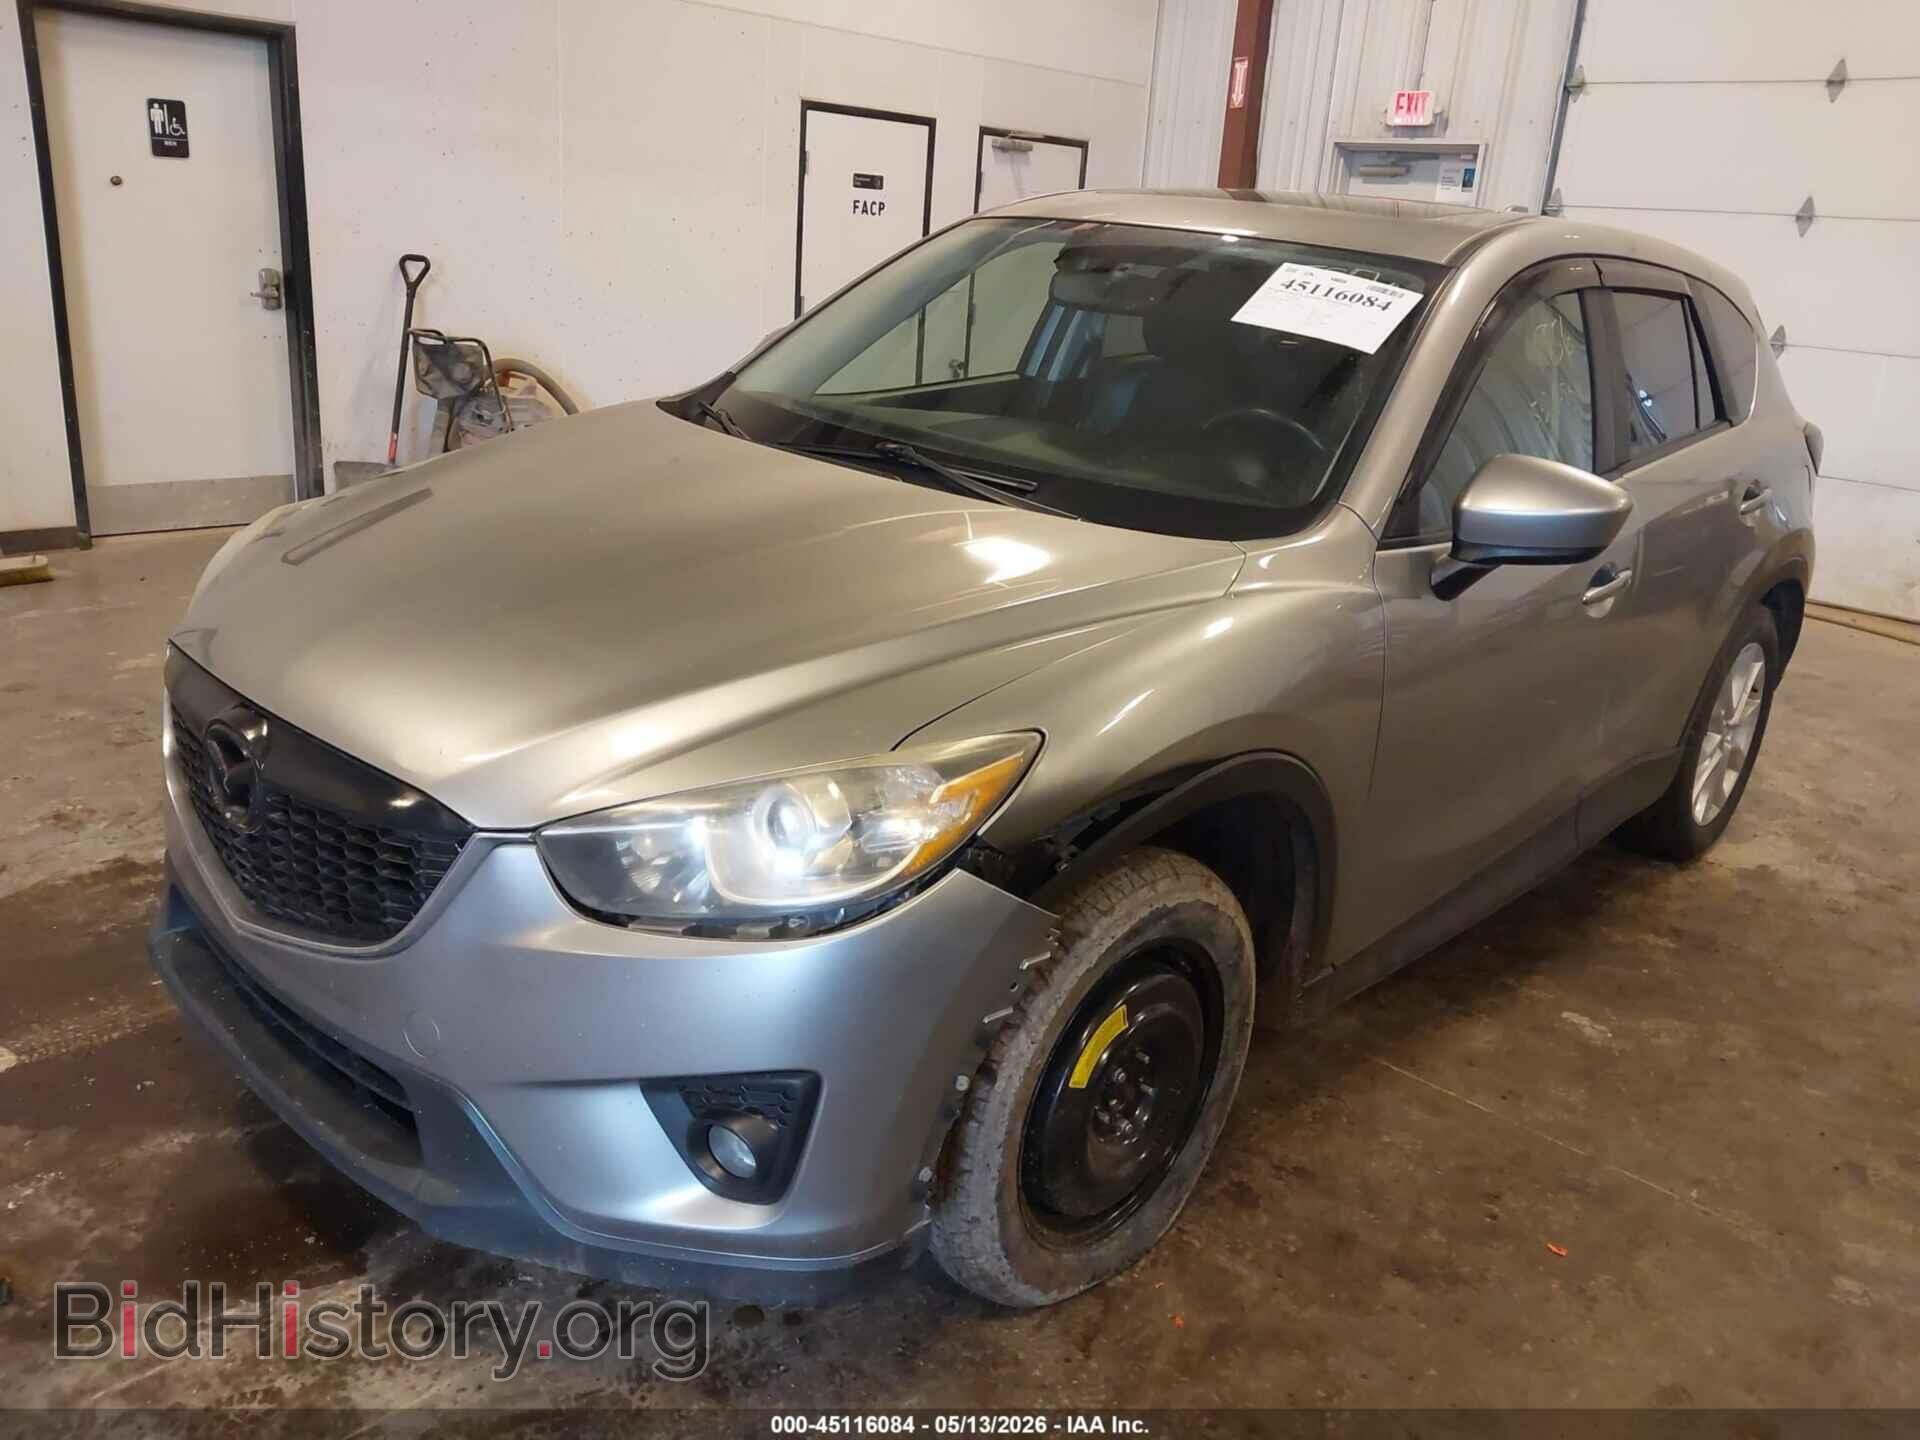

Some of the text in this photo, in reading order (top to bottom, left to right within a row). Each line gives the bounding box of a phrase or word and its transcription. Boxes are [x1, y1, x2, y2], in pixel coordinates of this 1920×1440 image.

[1395, 92, 1430, 113] EXIT
[853, 199, 885, 216] FACP
[1280, 279, 1393, 312] 45116084
